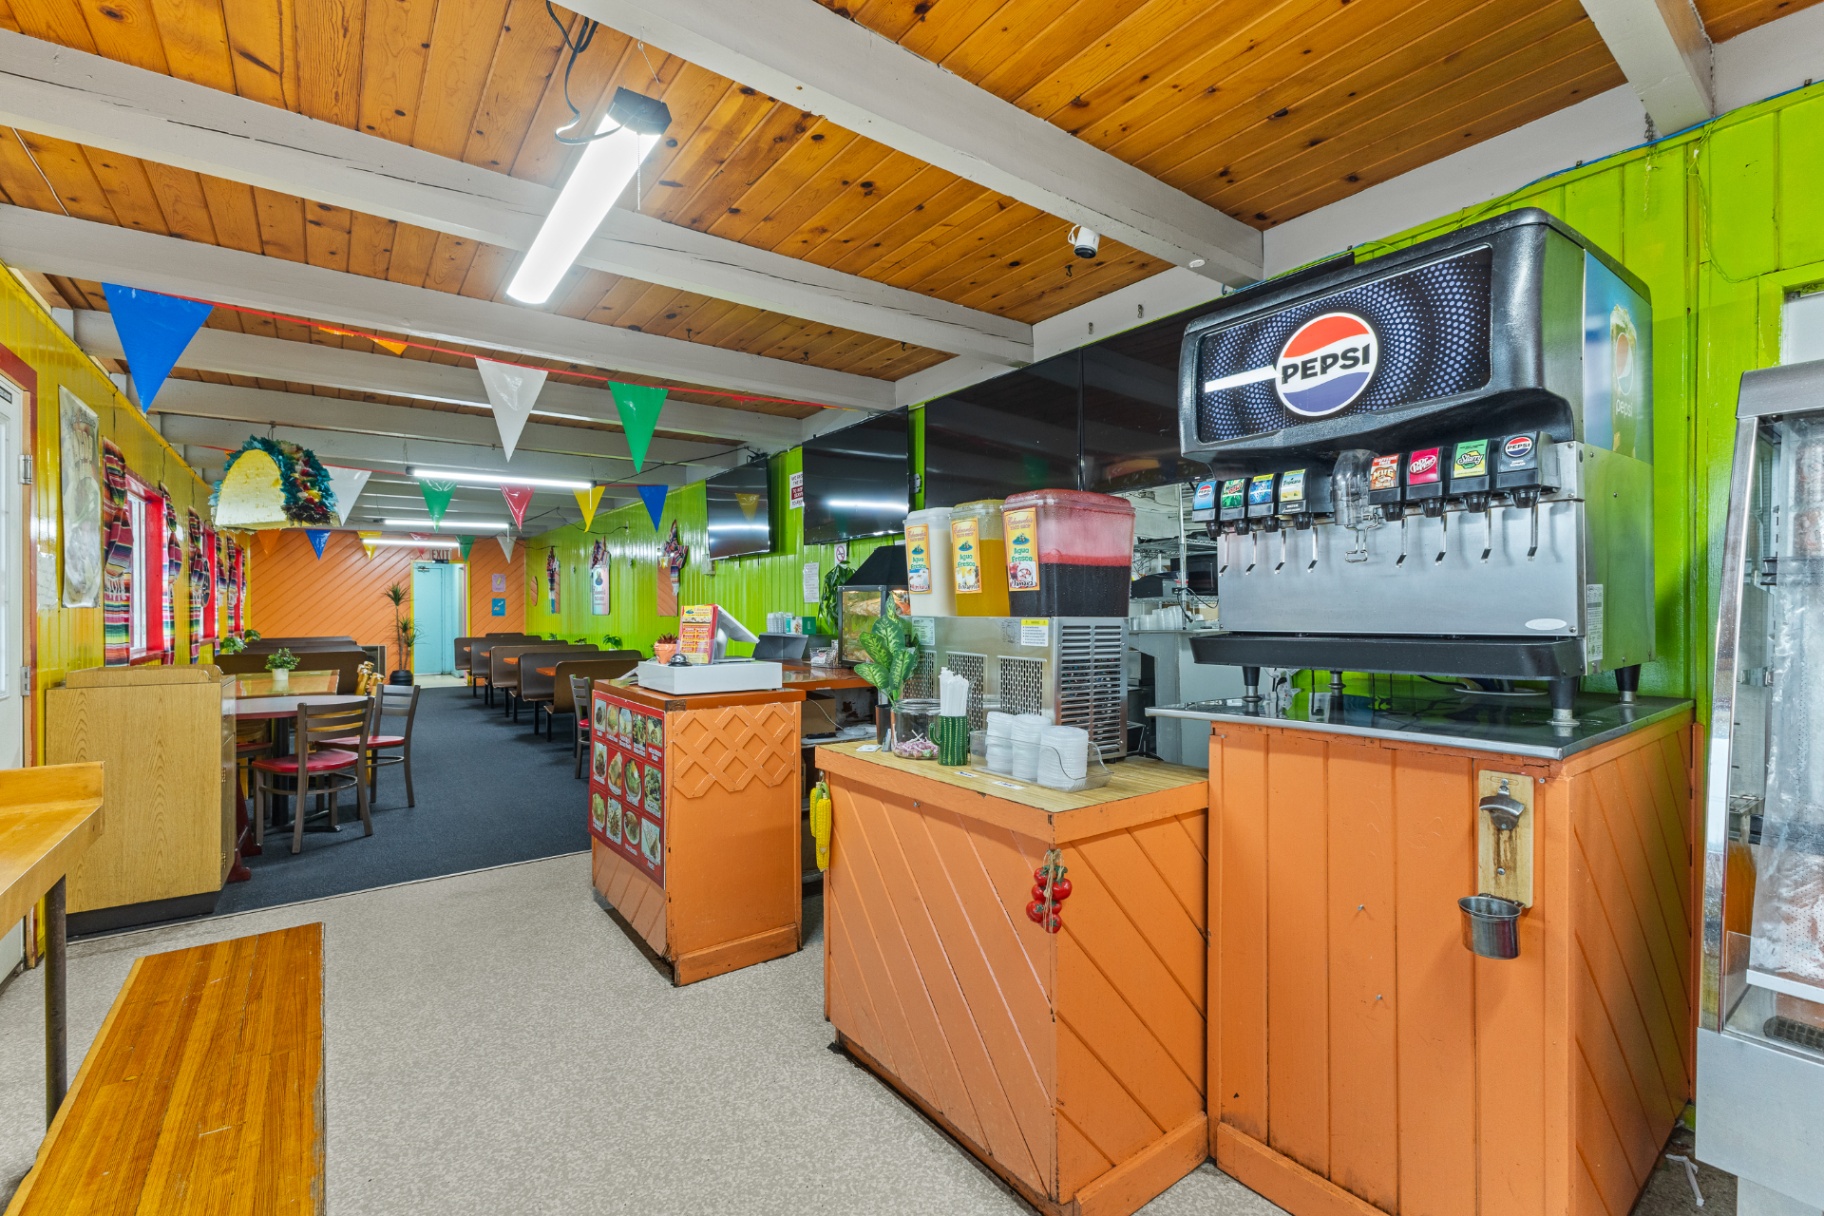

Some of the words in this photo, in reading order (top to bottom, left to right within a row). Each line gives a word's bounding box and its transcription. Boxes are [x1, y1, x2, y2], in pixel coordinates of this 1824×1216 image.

[1281, 343, 1370, 385] PEPSI
[1616, 399, 1633, 417] pepsi
[1507, 442, 1531, 451] PEPSI
[1456, 453, 1484, 465] Starry
[1283, 478, 1302, 487] Tropicana
[431, 549, 449, 560] EXIT
